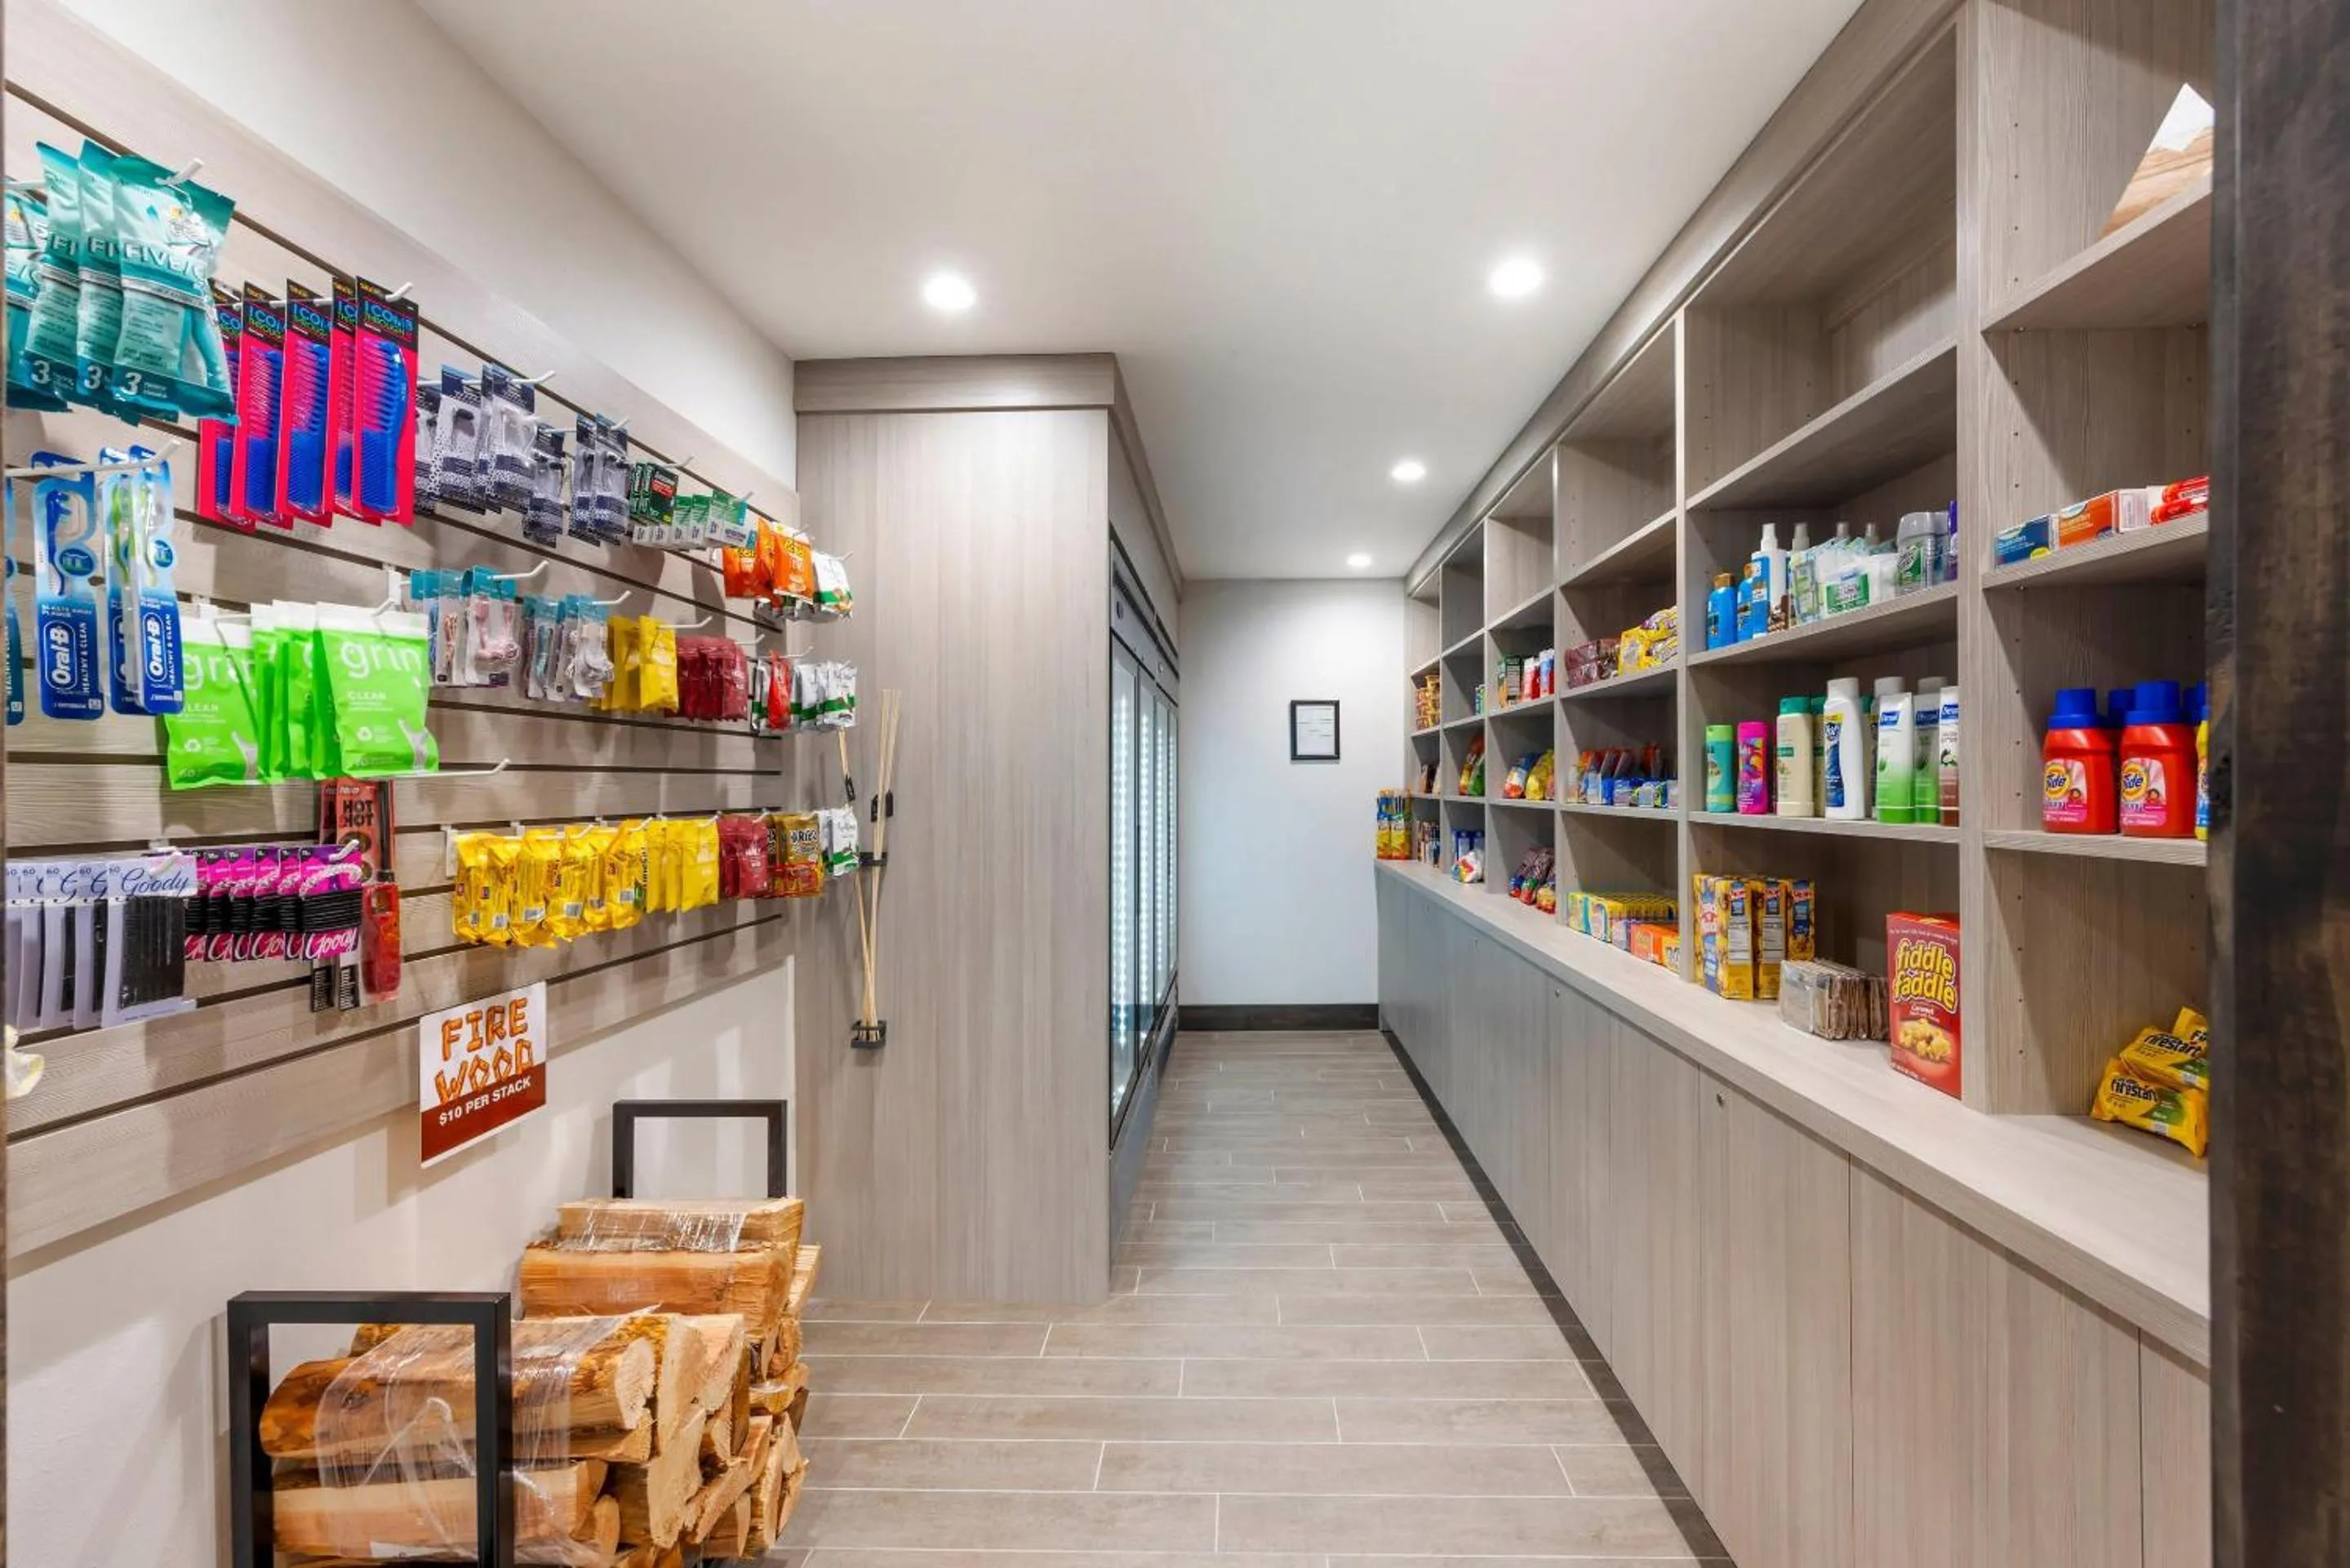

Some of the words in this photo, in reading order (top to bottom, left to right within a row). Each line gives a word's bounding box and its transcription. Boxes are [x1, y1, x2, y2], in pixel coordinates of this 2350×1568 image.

[31, 360, 50, 384] 3
[84, 364, 102, 389] 3
[121, 371, 142, 396] 3
[147, 618, 163, 676] Oral-B
[340, 641, 422, 679] grin
[186, 703, 219, 713] LEAN
[343, 800, 374, 813] HOT
[120, 867, 191, 900] Goody
[1897, 940, 1954, 980] fiddle
[1895, 971, 1956, 1011] faddle
[442, 997, 528, 1061] FIRE
[434, 1038, 533, 1105] WOOD
[439, 1105, 463, 1126] $10
[465, 1094, 490, 1114] PER
[491, 1076, 532, 1102] STACK
